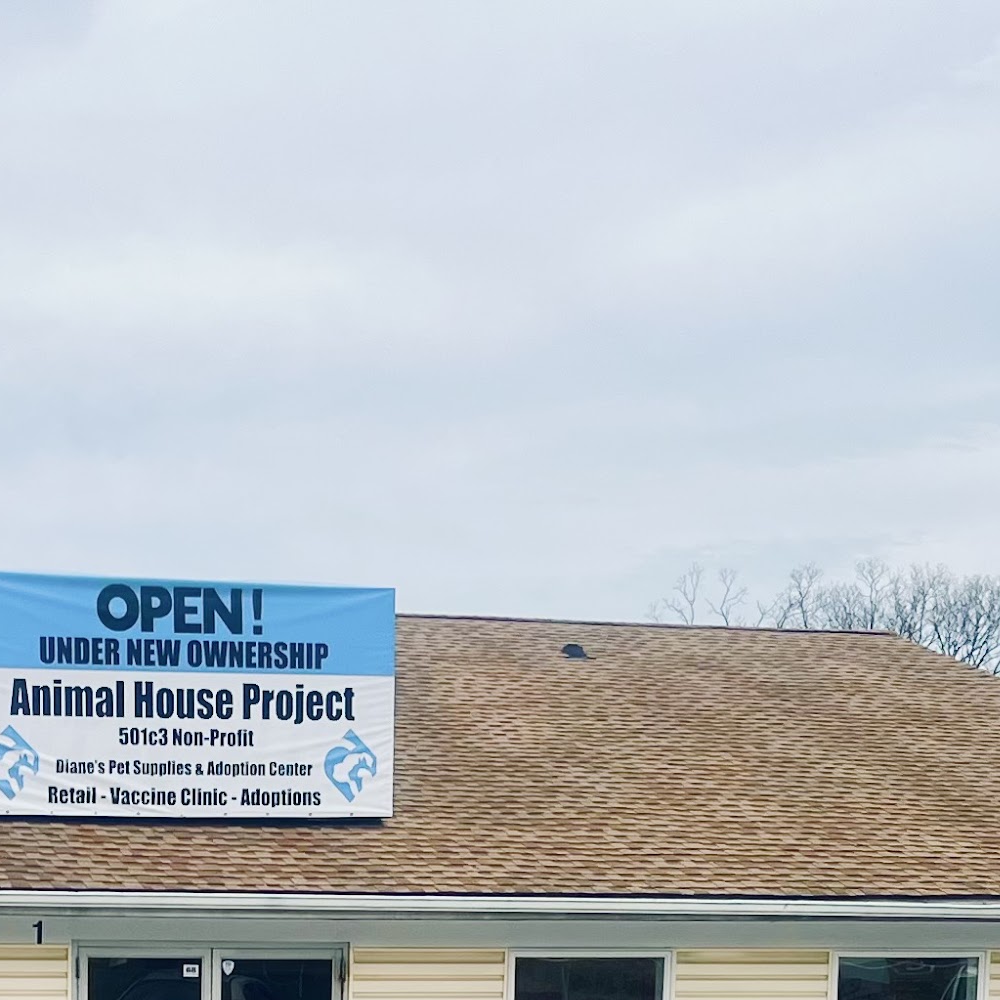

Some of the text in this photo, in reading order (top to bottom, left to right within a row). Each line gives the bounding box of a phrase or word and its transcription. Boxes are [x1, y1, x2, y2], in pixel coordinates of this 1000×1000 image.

[96, 583, 263, 635] OPEN!
[39, 636, 329, 670] UNDER NEW OWNERSHIP
[10, 678, 355, 724] Animal House Project
[118, 727, 254, 747] 501c3 Non-Profit
[56, 759, 313, 777] Diane's Pet Supplies & Adoption Center
[48, 786, 97, 804] Retail
[110, 787, 177, 806] Vaccine
[180, 788, 228, 806] Clinic
[240, 788, 321, 808] Adoptions
[32, 920, 43, 945] 1
